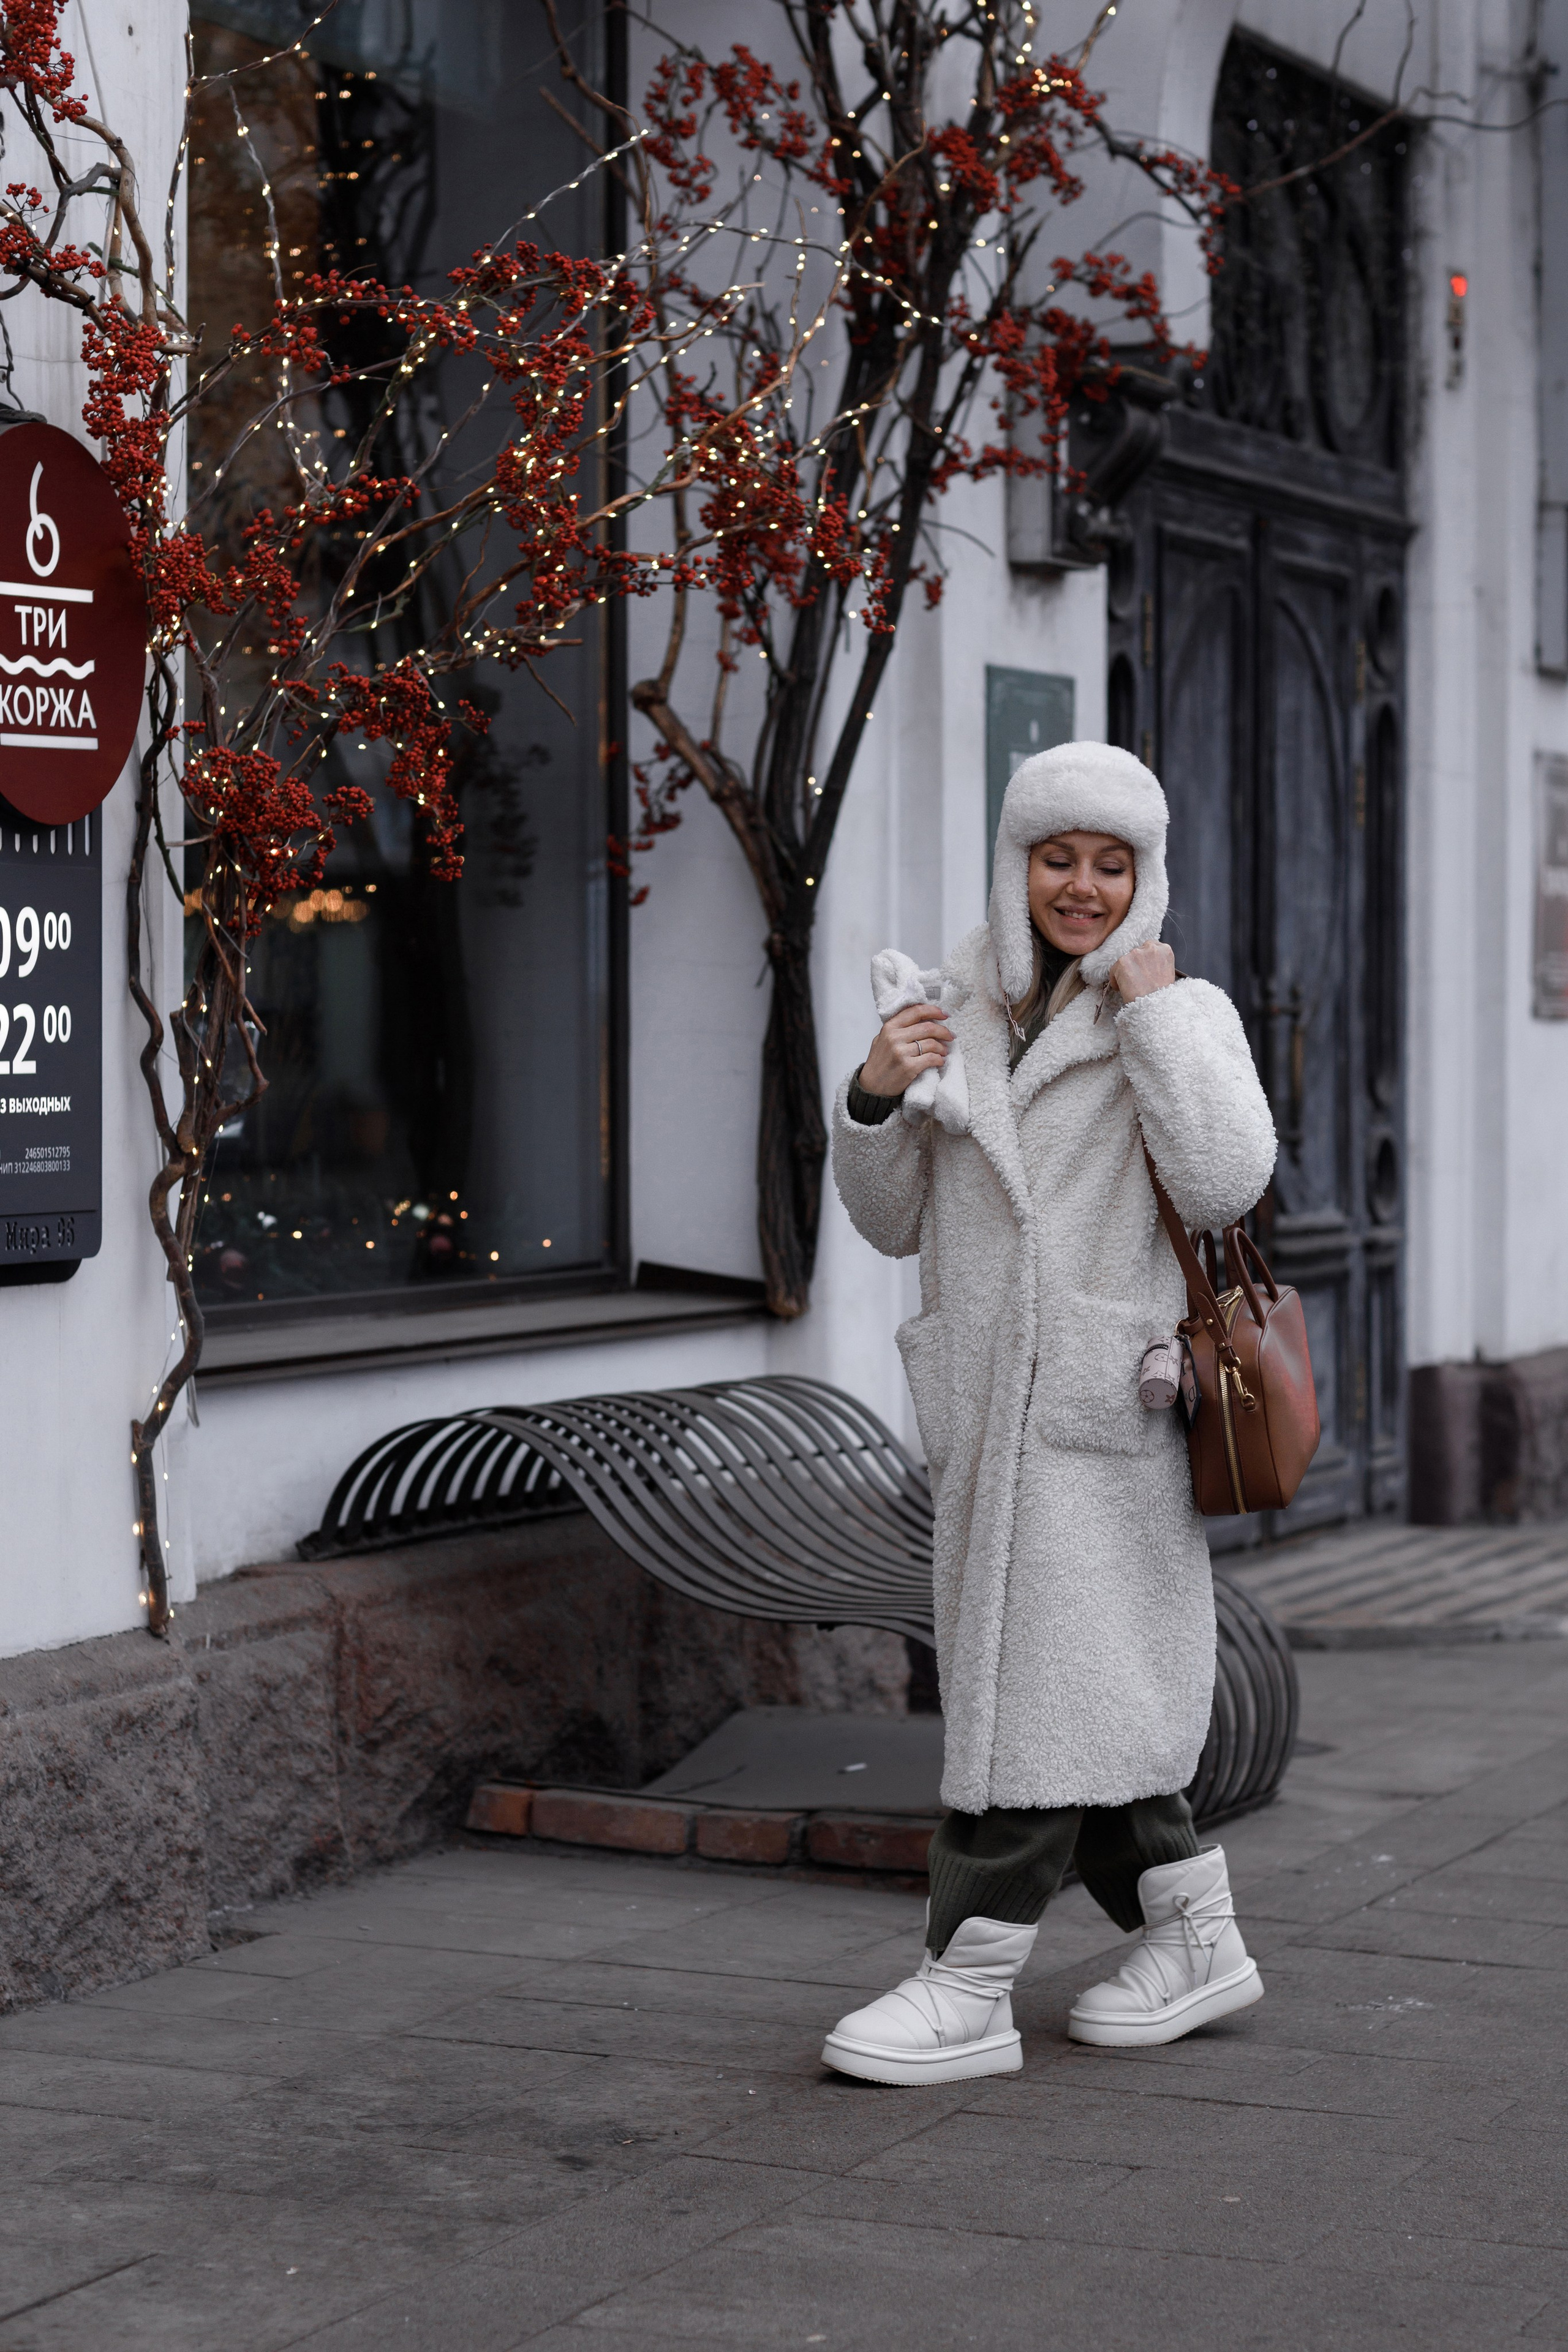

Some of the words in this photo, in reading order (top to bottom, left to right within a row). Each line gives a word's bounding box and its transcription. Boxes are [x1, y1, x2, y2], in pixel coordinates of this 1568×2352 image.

[14, 604, 67, 649] ТРИ
[0, 684, 97, 729] КОРЖА
[9, 1096, 71, 1115] ВЫХОДНЫХ
[25, 1146, 70, 1159] 246501512795
[14, 1159, 70, 1174] 312246803800133
[5, 1221, 51, 1255] Мира
